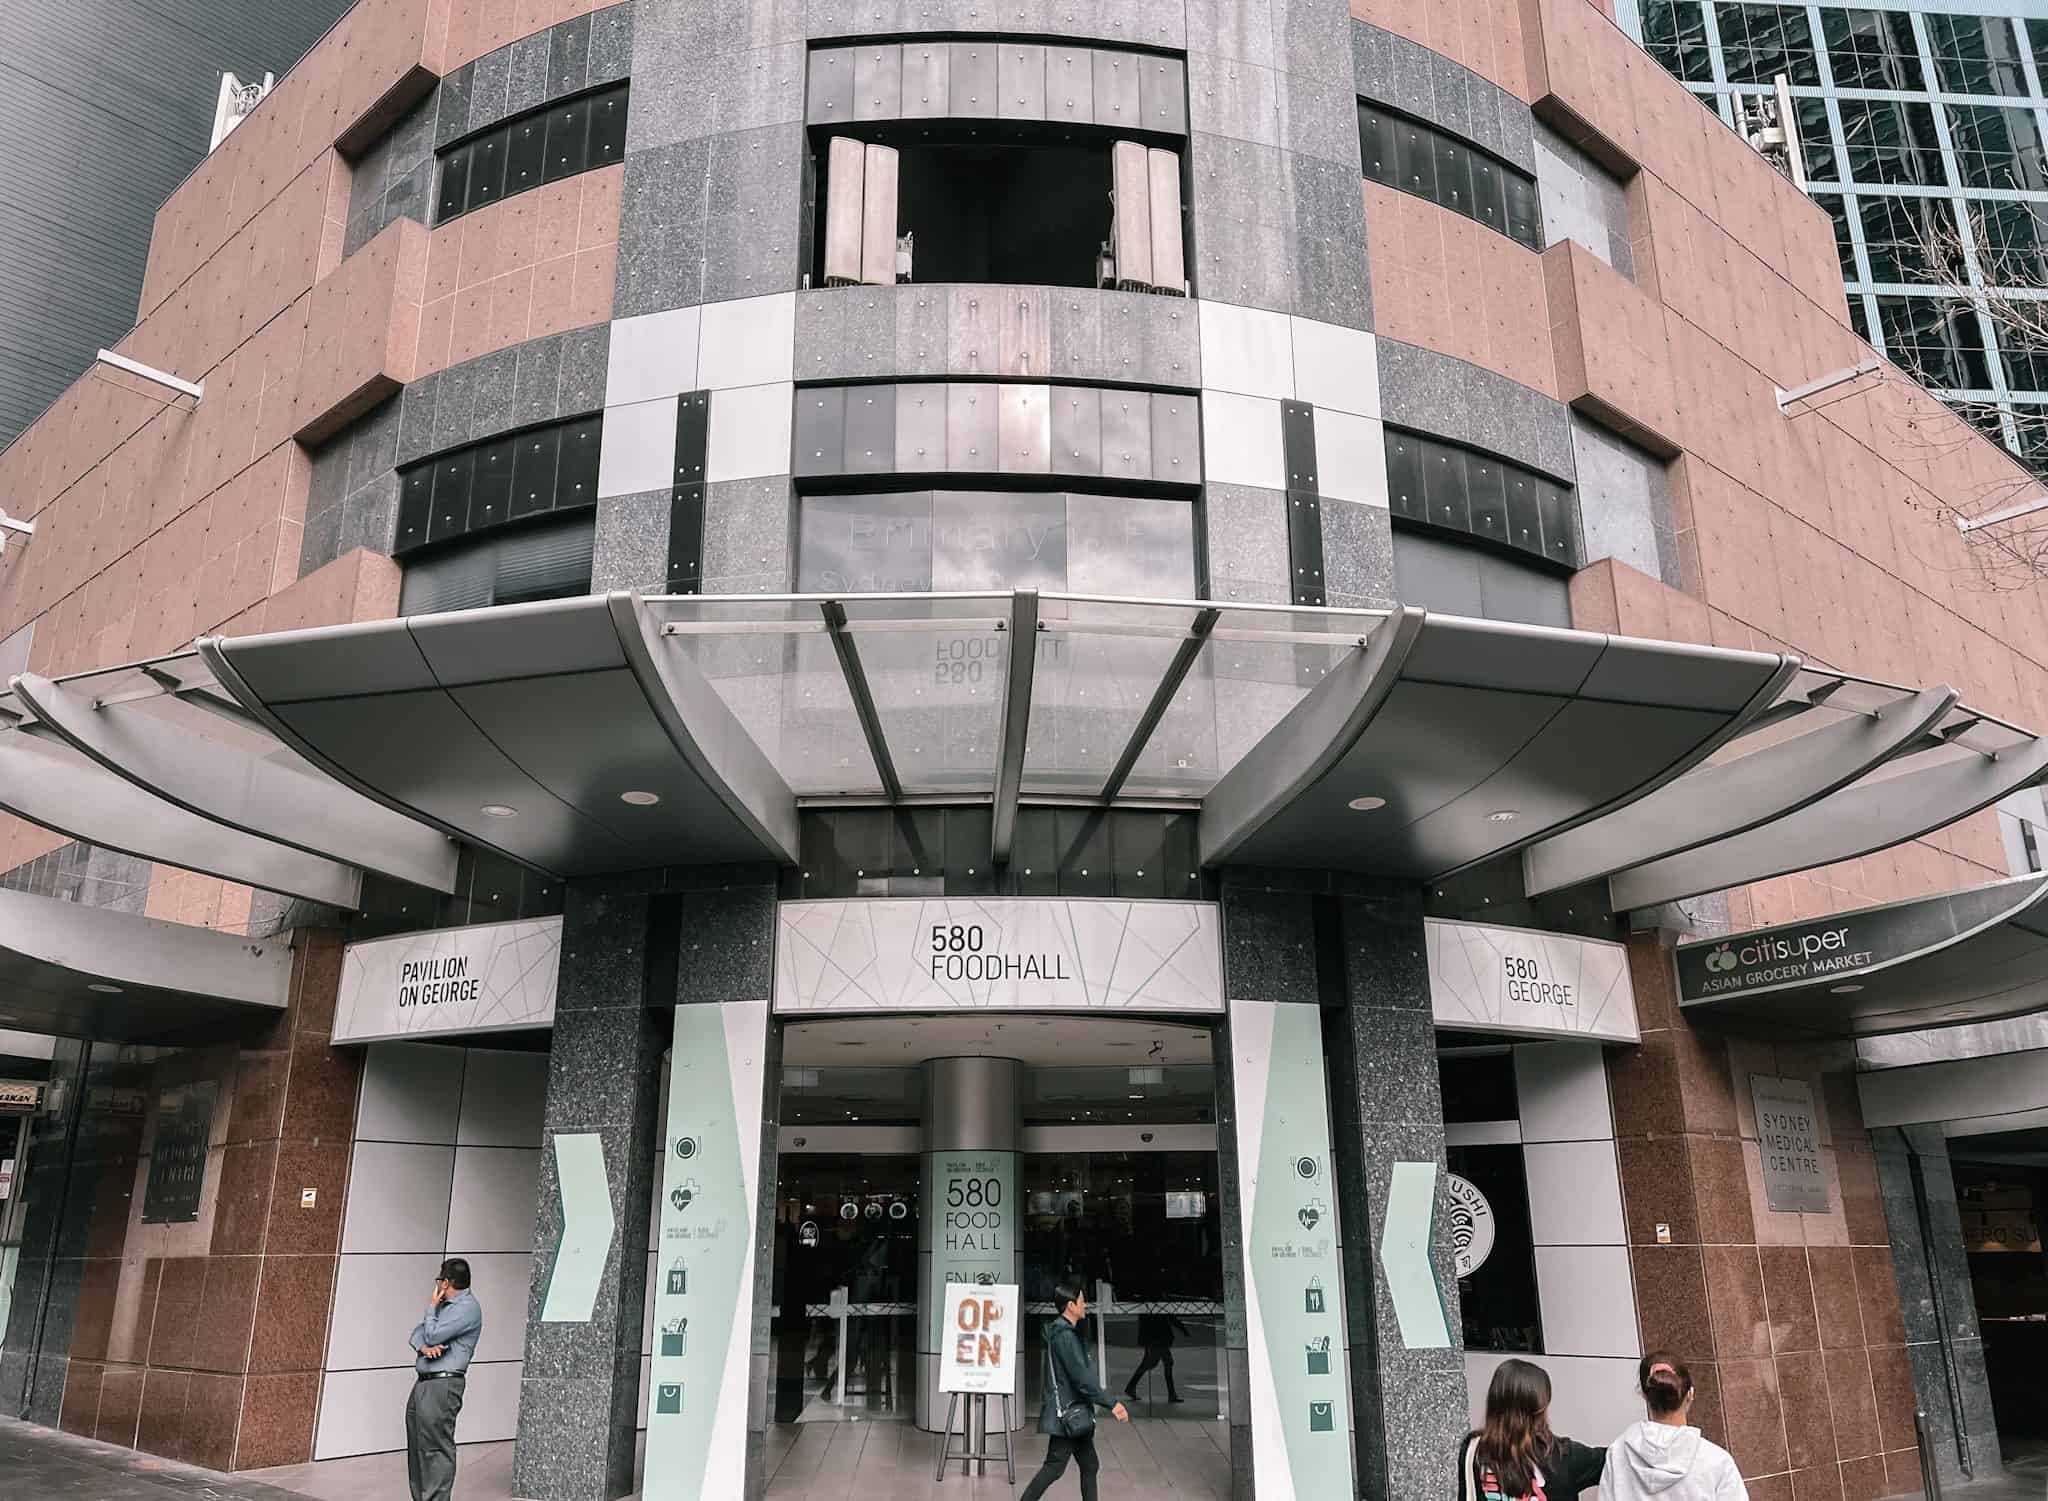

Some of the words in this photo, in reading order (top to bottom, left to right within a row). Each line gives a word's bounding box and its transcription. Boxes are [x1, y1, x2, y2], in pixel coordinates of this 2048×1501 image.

[931, 925, 984, 952] 580
[1740, 927, 1849, 966] citisuper
[402, 956, 468, 983] PAVILION
[932, 954, 1071, 980] FOODHALL
[1505, 957, 1538, 979] 580
[1702, 976, 1742, 993] ASIAN
[1746, 963, 1808, 985] GROCERY
[1813, 951, 1872, 972] MARKET
[399, 986, 418, 1007] ON
[422, 979, 479, 1005] GEORGE
[1508, 980, 1574, 1006] GEORGE
[1763, 1113, 1810, 1132] SYDNEY
[1766, 1135, 1815, 1153] MEDICAL
[1770, 1155, 1819, 1174] CENTRE
[946, 1178, 1001, 1207] 580
[946, 1212, 1001, 1229] FOOD
[946, 1232, 1001, 1250] HALL
